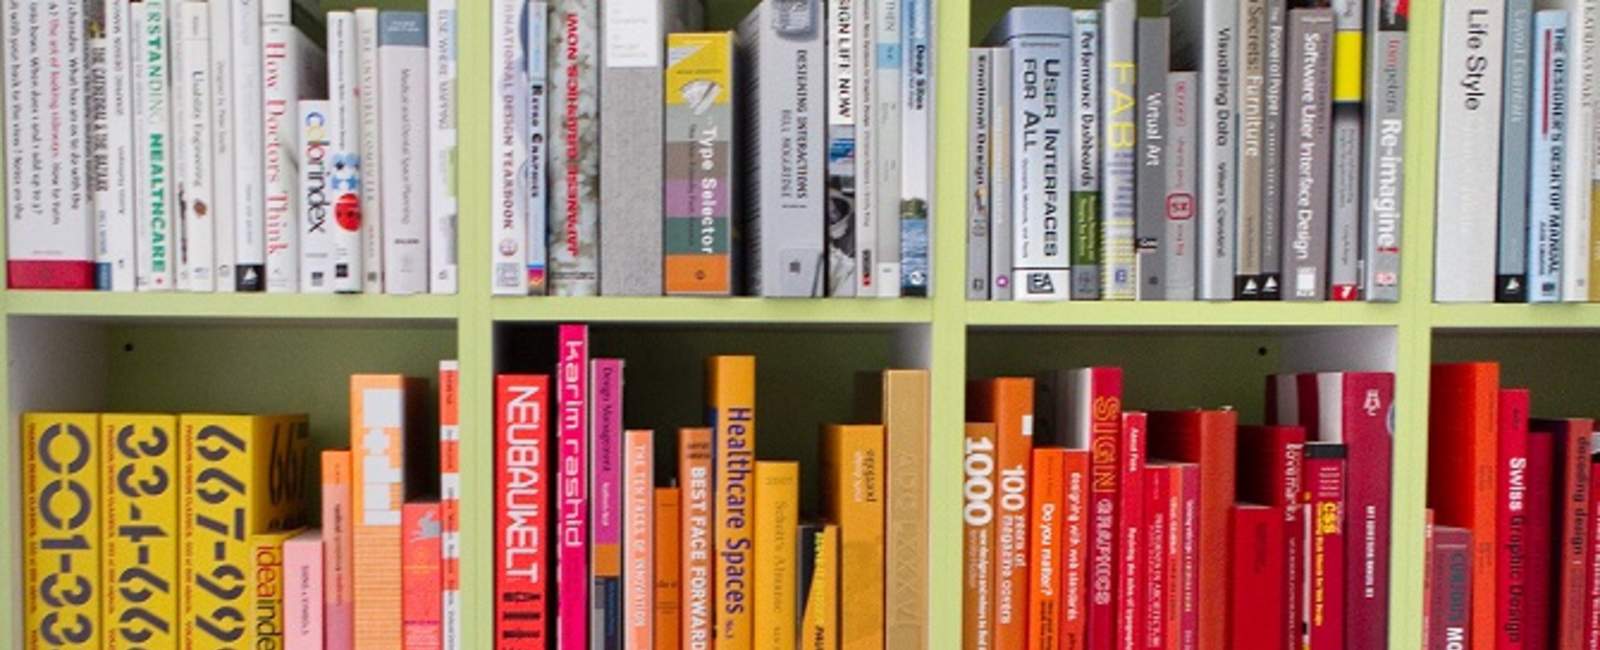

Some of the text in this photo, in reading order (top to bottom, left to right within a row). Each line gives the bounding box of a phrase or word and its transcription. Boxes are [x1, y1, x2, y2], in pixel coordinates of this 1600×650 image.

[266, 42, 287, 88] How
[838, 40, 850, 68] LIFE
[1246, 9, 1263, 156] Secrets: Furniture
[1460, 9, 1489, 110] Life Style
[1554, 28, 1566, 52] THE
[566, 66, 580, 158] GRAPHICS
[796, 50, 806, 200] DESIGNING INTERACTIONS
[838, 78, 851, 118] NOW
[1080, 32, 1094, 186] Performance Dashboards
[1108, 60, 1136, 150] FAB
[1146, 92, 1162, 166] Virtual Art
[1214, 28, 1230, 146] Visualizing Data
[267, 100, 288, 183] Doctors
[306, 112, 330, 234] colorindex
[504, 95, 514, 230] DESIGN YEARBOOK
[1294, 33, 1320, 260] Software User Interface Design
[1374, 119, 1402, 253] Re-imagine!
[1550, 146, 1562, 210] DESKTOP
[150, 134, 166, 272] HEALTHCARE
[267, 192, 288, 256] Think
[566, 164, 580, 256] JAPANESE
[698, 126, 718, 254] Type Selector
[1548, 215, 1560, 274] MANUAL
[506, 384, 540, 583] NEUBAUWELT
[564, 340, 584, 547] karim rashid
[964, 436, 994, 526] 1000
[1001, 464, 1026, 510] 100
[1128, 427, 1140, 472] About Face
[1508, 458, 1526, 511] Swiss
[38, 422, 93, 650] 001-33
[117, 422, 170, 650] 334-66
[196, 424, 246, 650] 667-99
[722, 408, 752, 614] Healthcare Spaces
[1040, 524, 1052, 545] you
[1042, 503, 1054, 520] Do
[1068, 472, 1082, 520] designing
[1068, 525, 1082, 545] with
[1092, 395, 1120, 604] SIGN GRAPHICS
[1323, 503, 1336, 533] CSS
[1572, 507, 1587, 555] design
[690, 466, 706, 650] BEST FACE FORWARD
[1000, 515, 1013, 624] magazine covers
[1041, 548, 1054, 596] matter?
[1068, 548, 1080, 569] web
